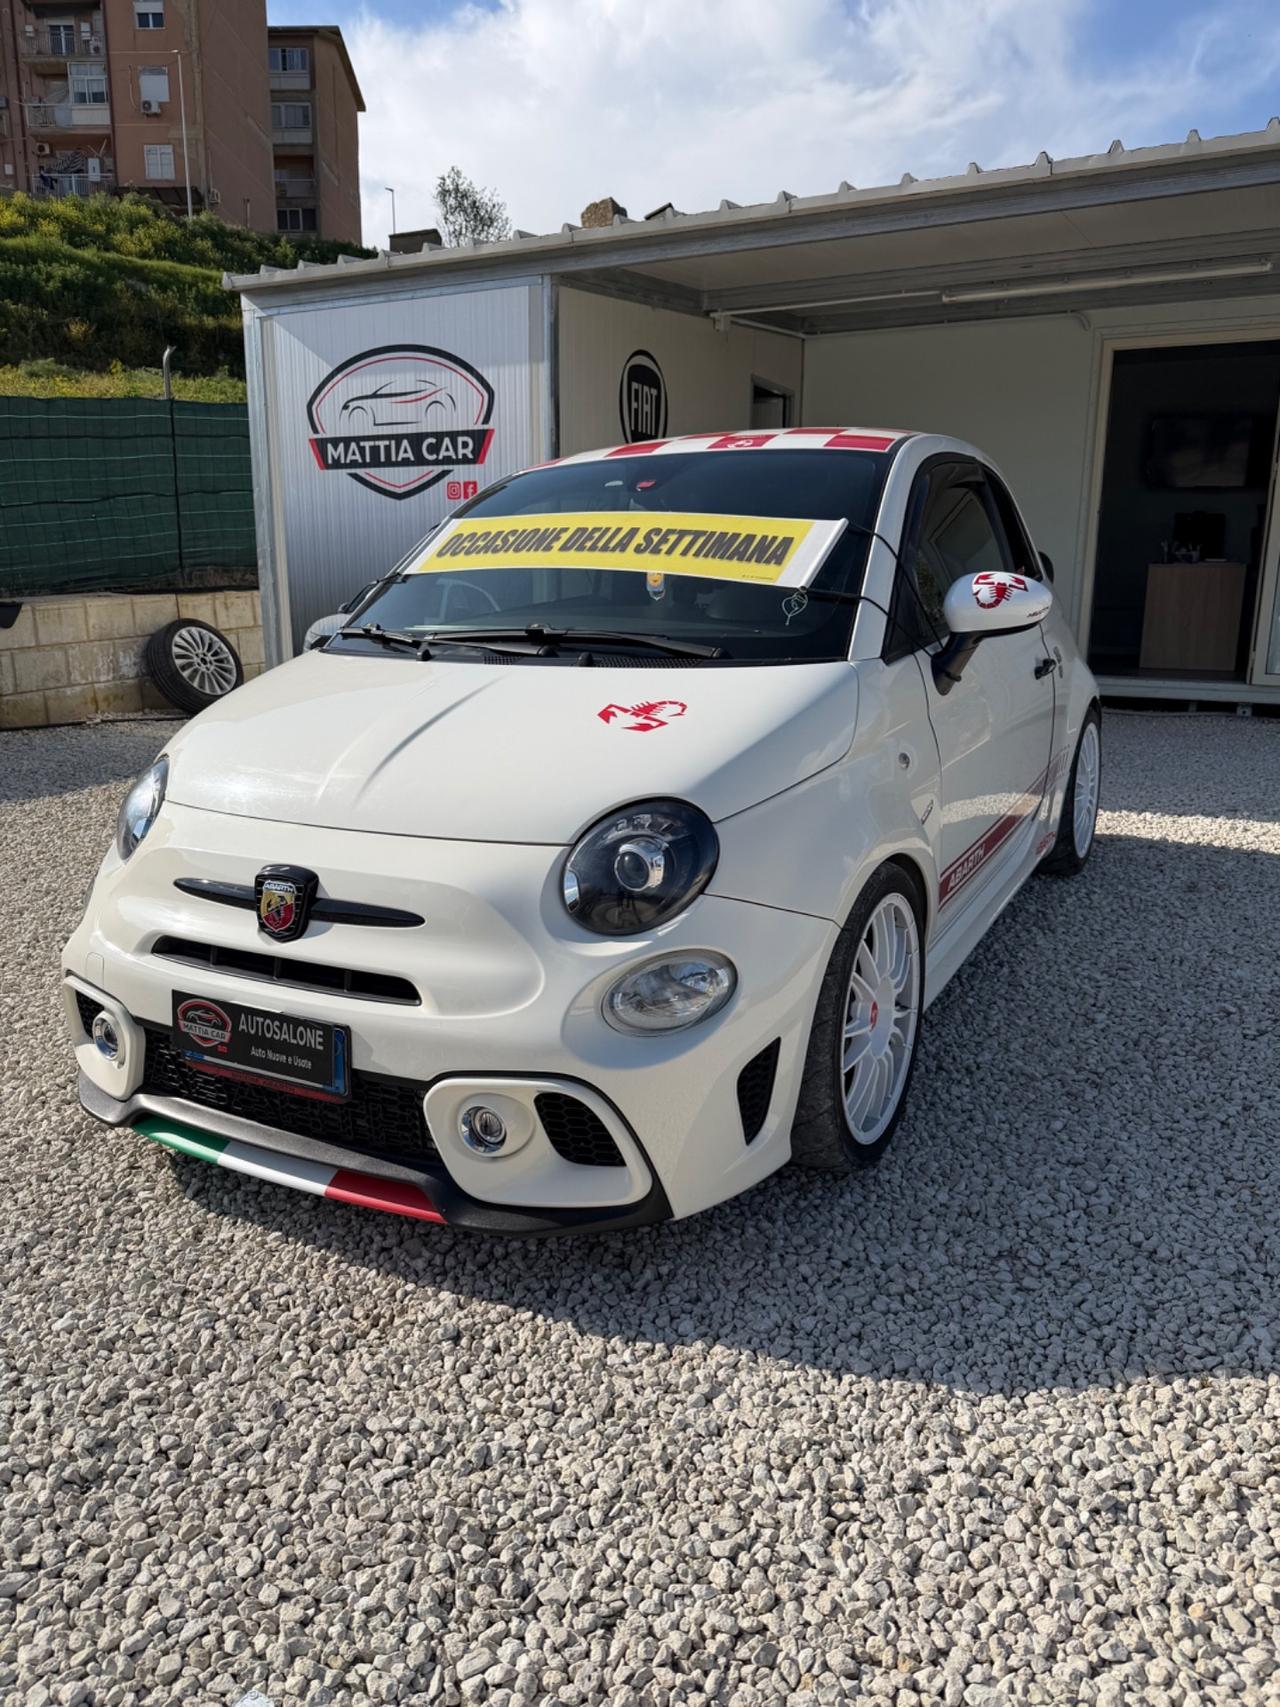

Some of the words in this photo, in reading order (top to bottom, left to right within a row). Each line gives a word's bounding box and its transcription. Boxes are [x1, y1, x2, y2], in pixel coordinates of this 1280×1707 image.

[631, 381, 657, 436] FIAT
[327, 439, 416, 465] MATTIA
[422, 437, 475, 461] CAR
[437, 526, 568, 559] OCCASIONE
[558, 526, 640, 553] DELLA
[634, 528, 795, 567] SETTIMANA
[184, 1022, 210, 1037] MATTIA
[211, 1029, 226, 1041] CAR
[239, 1014, 324, 1050] AUTOSALONE
[251, 1045, 266, 1059] Auto
